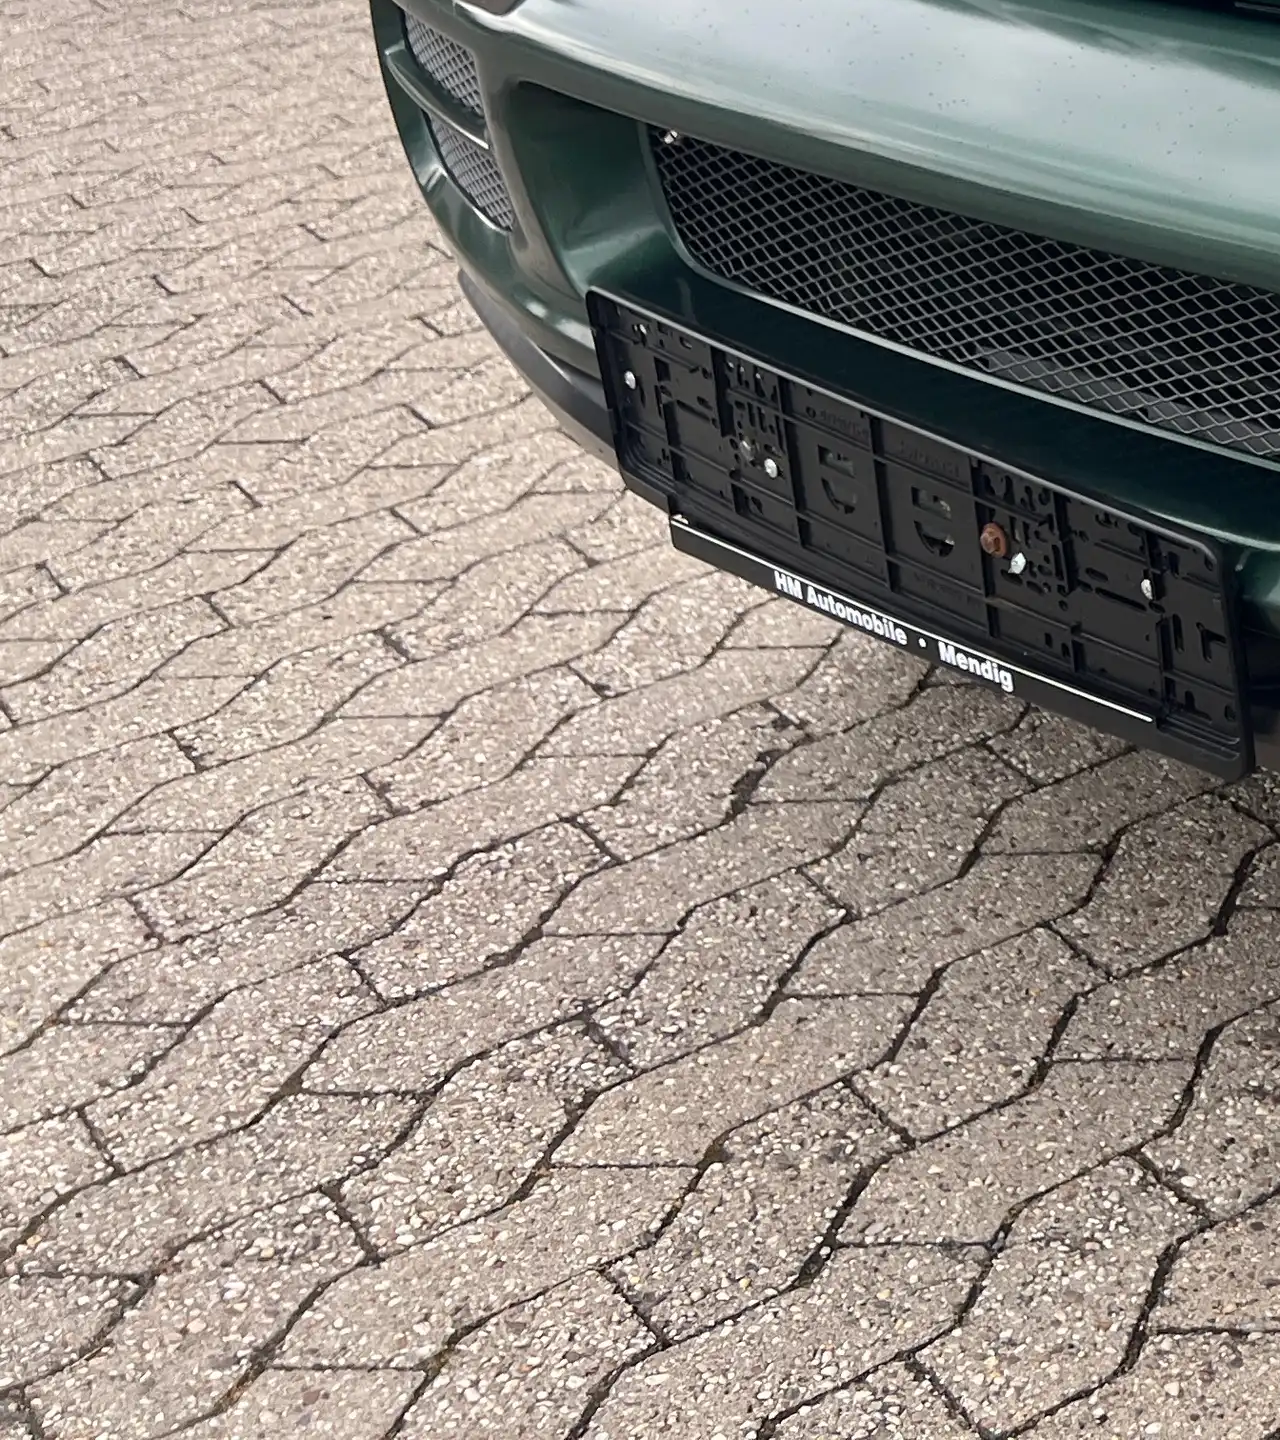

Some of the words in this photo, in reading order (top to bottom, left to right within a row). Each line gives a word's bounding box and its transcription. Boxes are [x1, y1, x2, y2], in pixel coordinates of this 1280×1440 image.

[774, 570, 803, 600] HM
[806, 585, 908, 646] Automobile
[938, 641, 1014, 693] Mendig
